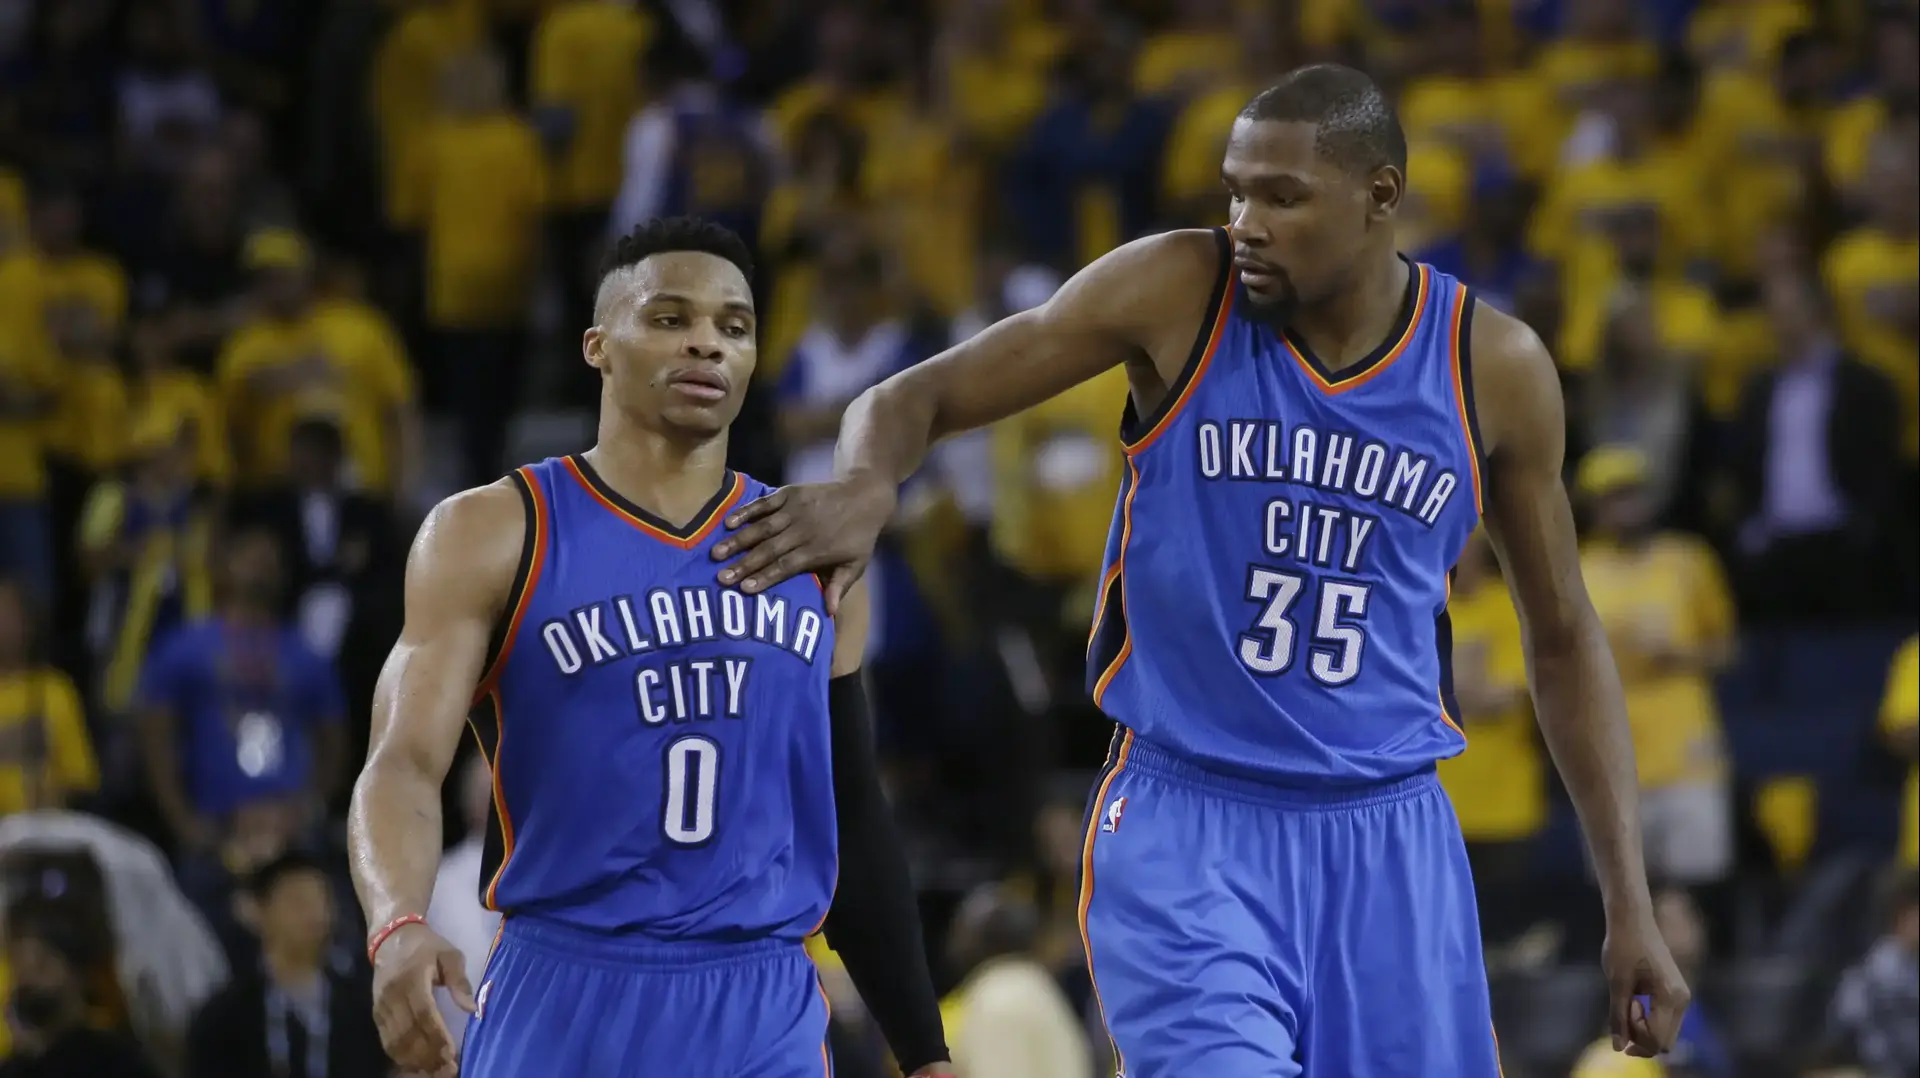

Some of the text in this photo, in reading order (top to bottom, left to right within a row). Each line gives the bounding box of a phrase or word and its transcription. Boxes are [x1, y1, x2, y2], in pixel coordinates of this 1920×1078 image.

[1197, 420, 1458, 527] OKLAHOMA
[1264, 498, 1375, 571] CITY
[540, 588, 823, 676] OKLAHOMA
[1237, 564, 1371, 687] 35
[635, 657, 751, 725] CITY
[662, 735, 719, 846] 0
